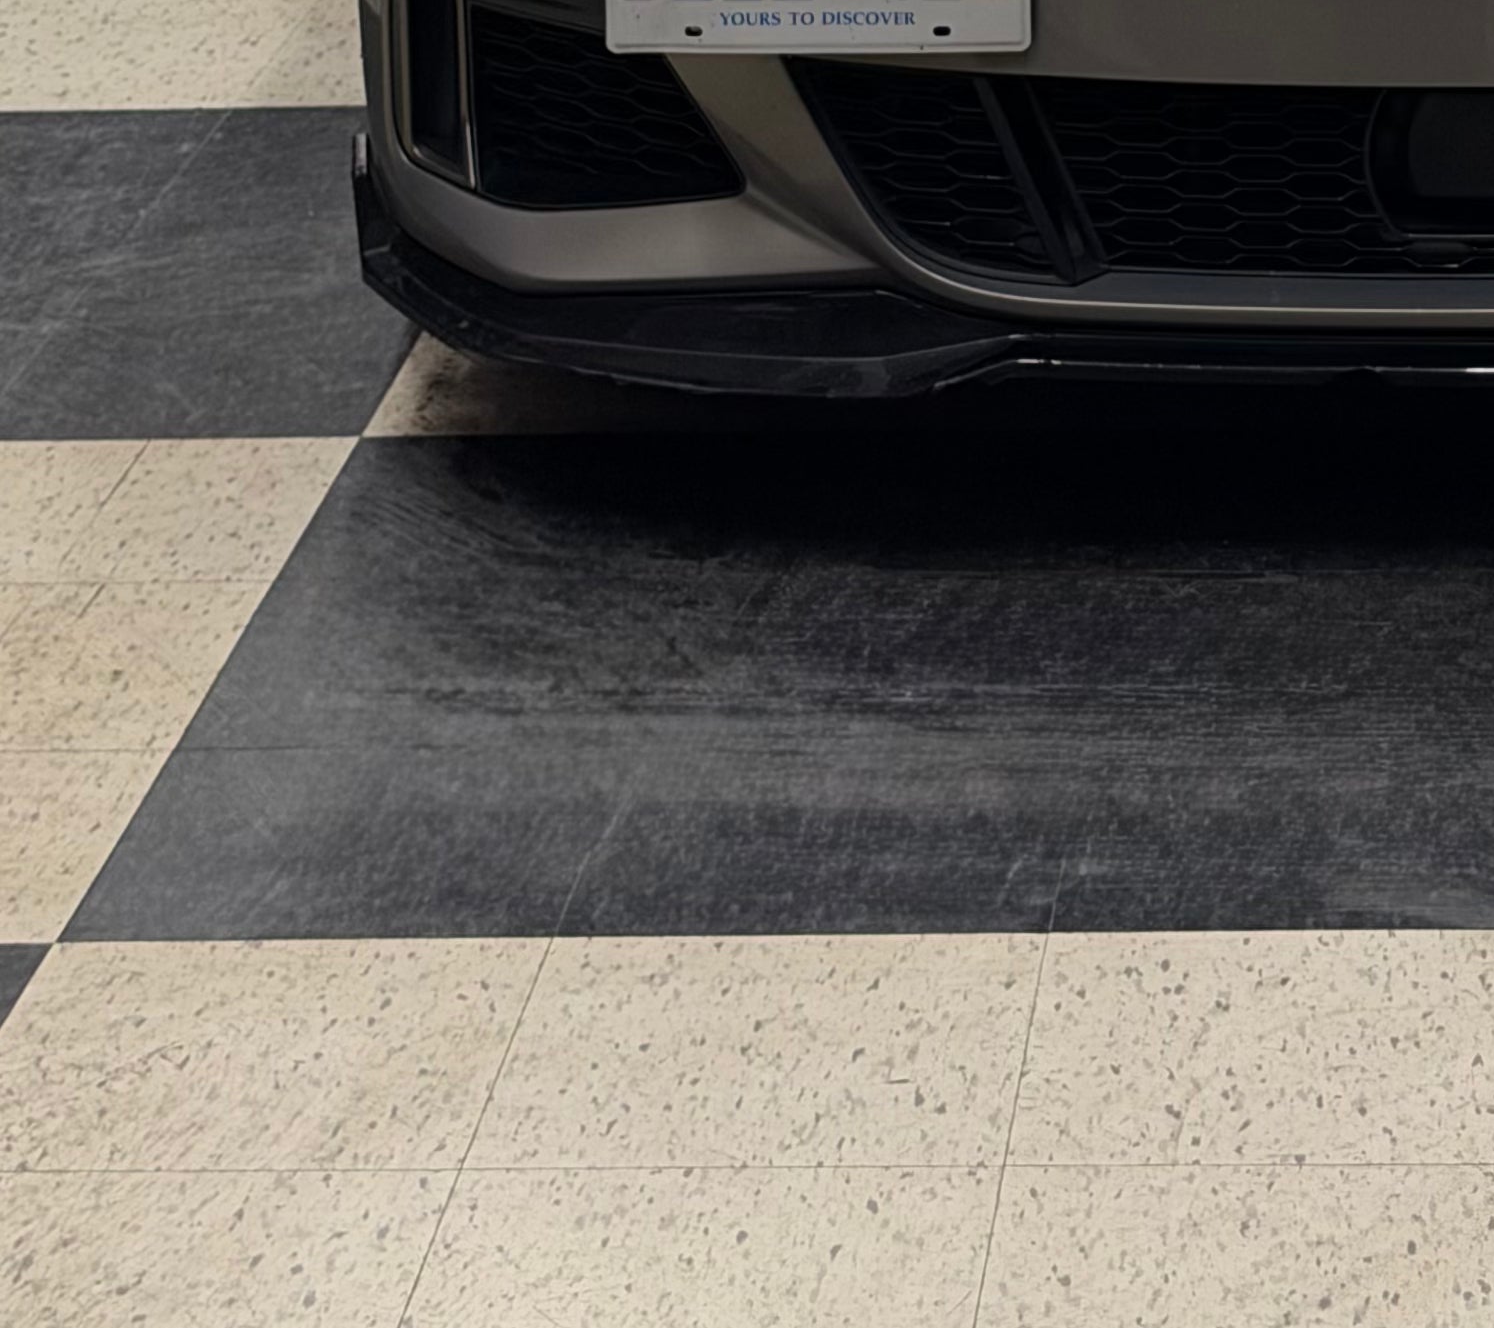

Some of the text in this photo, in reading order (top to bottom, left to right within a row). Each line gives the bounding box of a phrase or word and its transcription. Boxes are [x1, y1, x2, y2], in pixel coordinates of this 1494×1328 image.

[720, 11, 916, 27] YOURS TO DISCOVER
